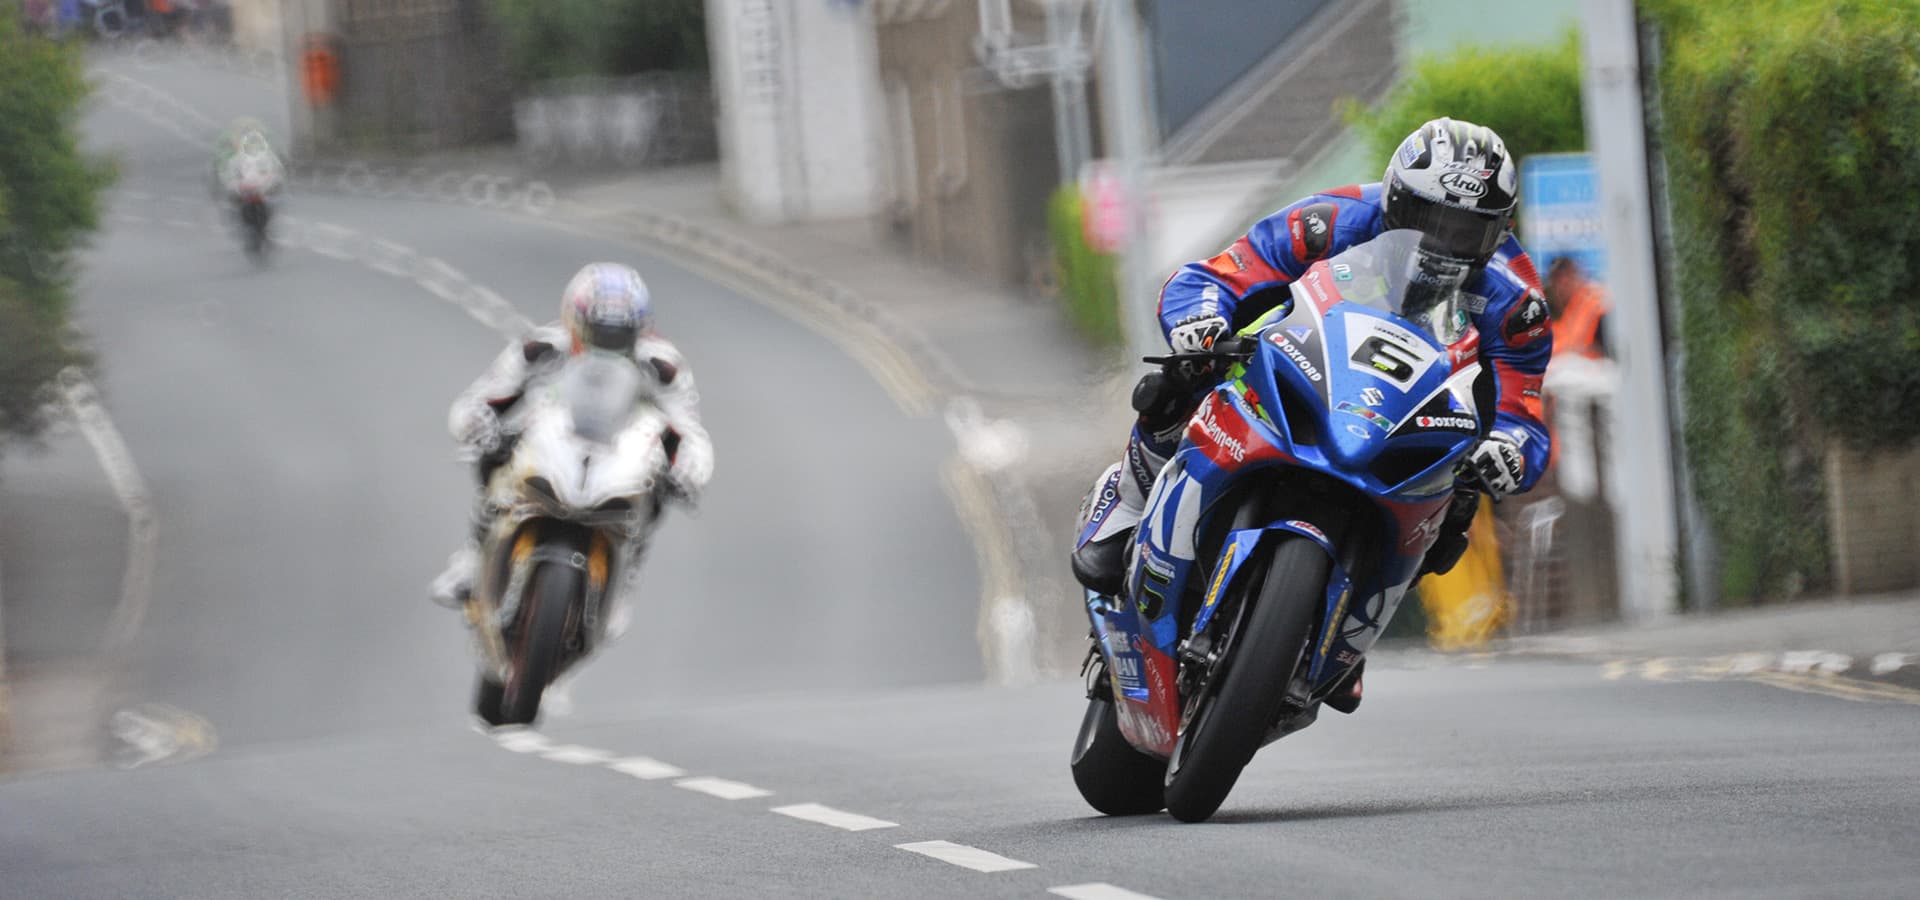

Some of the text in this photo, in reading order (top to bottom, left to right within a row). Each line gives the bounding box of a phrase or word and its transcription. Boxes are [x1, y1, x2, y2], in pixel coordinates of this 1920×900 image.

[1446, 172, 1481, 194] Arai
[1283, 343, 1322, 381] OXFORD
[1435, 416, 1476, 430] OXFORD
[1207, 417, 1246, 462] Bennetts
